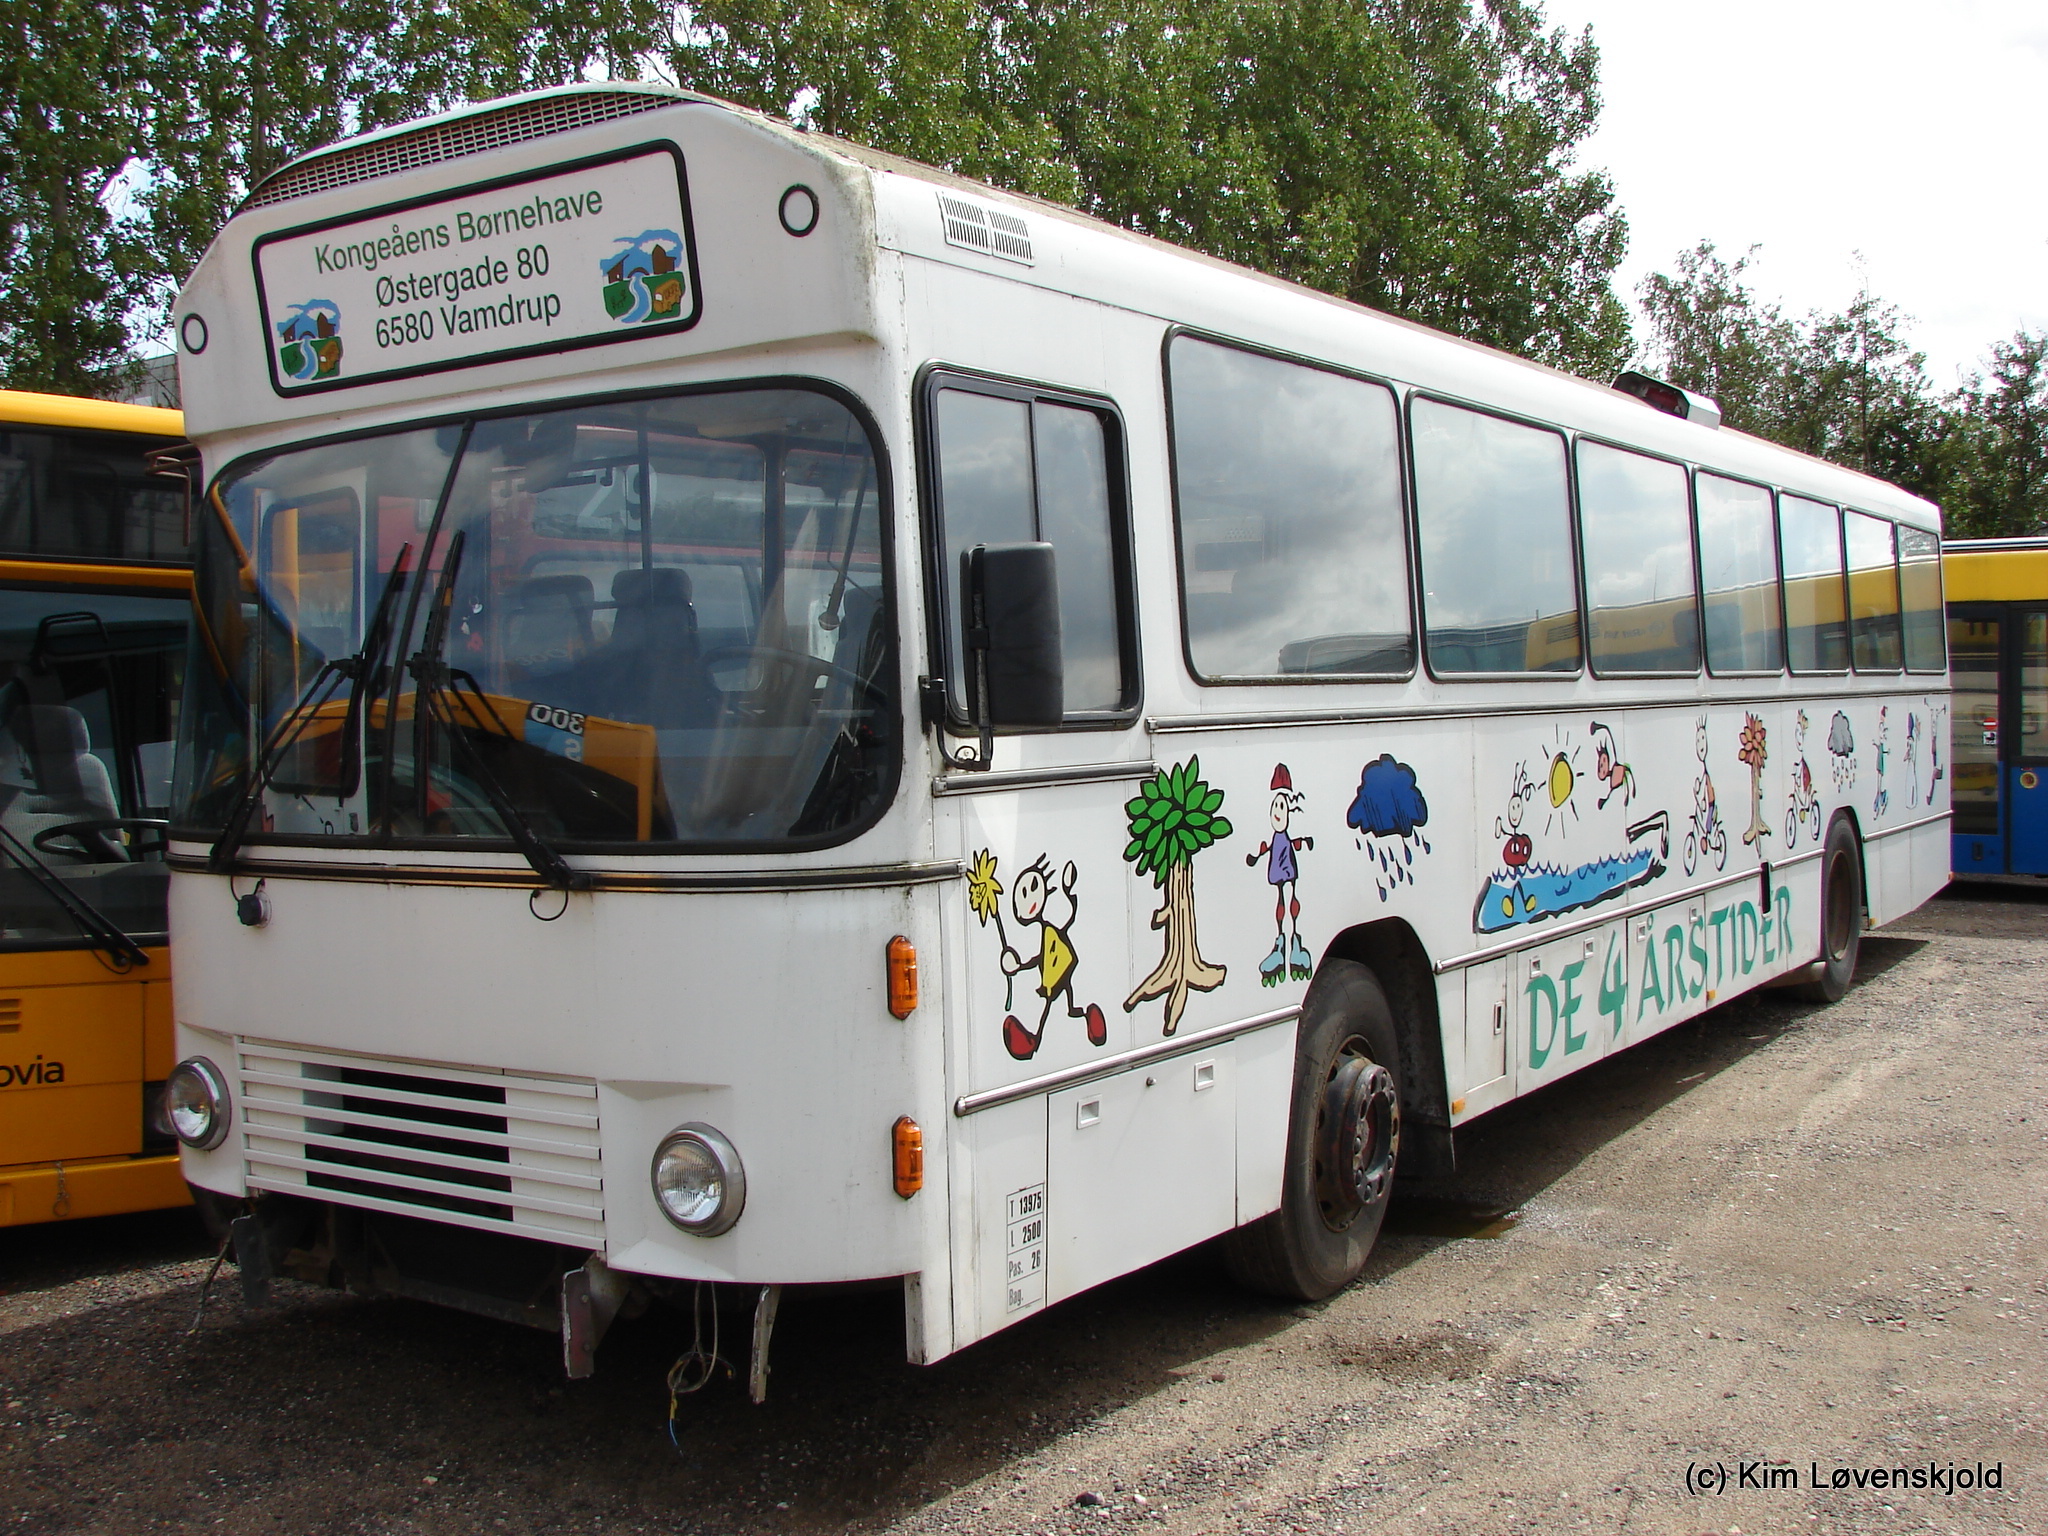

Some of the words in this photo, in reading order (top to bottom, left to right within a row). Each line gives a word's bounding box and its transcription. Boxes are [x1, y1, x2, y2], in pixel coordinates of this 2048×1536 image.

[315, 224, 450, 274] Kongeåens
[456, 190, 603, 243] Børnehave
[375, 255, 509, 308] Østergade
[516, 244, 550, 280] 80
[375, 309, 434, 349] 6580
[440, 292, 562, 336] Vamdrup
[1524, 960, 1588, 1069] DE
[1598, 929, 1627, 1041] 4
[1636, 886, 1793, 1025] ÅRSTIDER
[1020, 1191, 1042, 1215] 13975
[1022, 1220, 1042, 1244] 2500
[1009, 1260, 1024, 1278] Pas.
[1031, 1249, 1041, 1270] 26
[1009, 1288, 1024, 1306] Bag.
